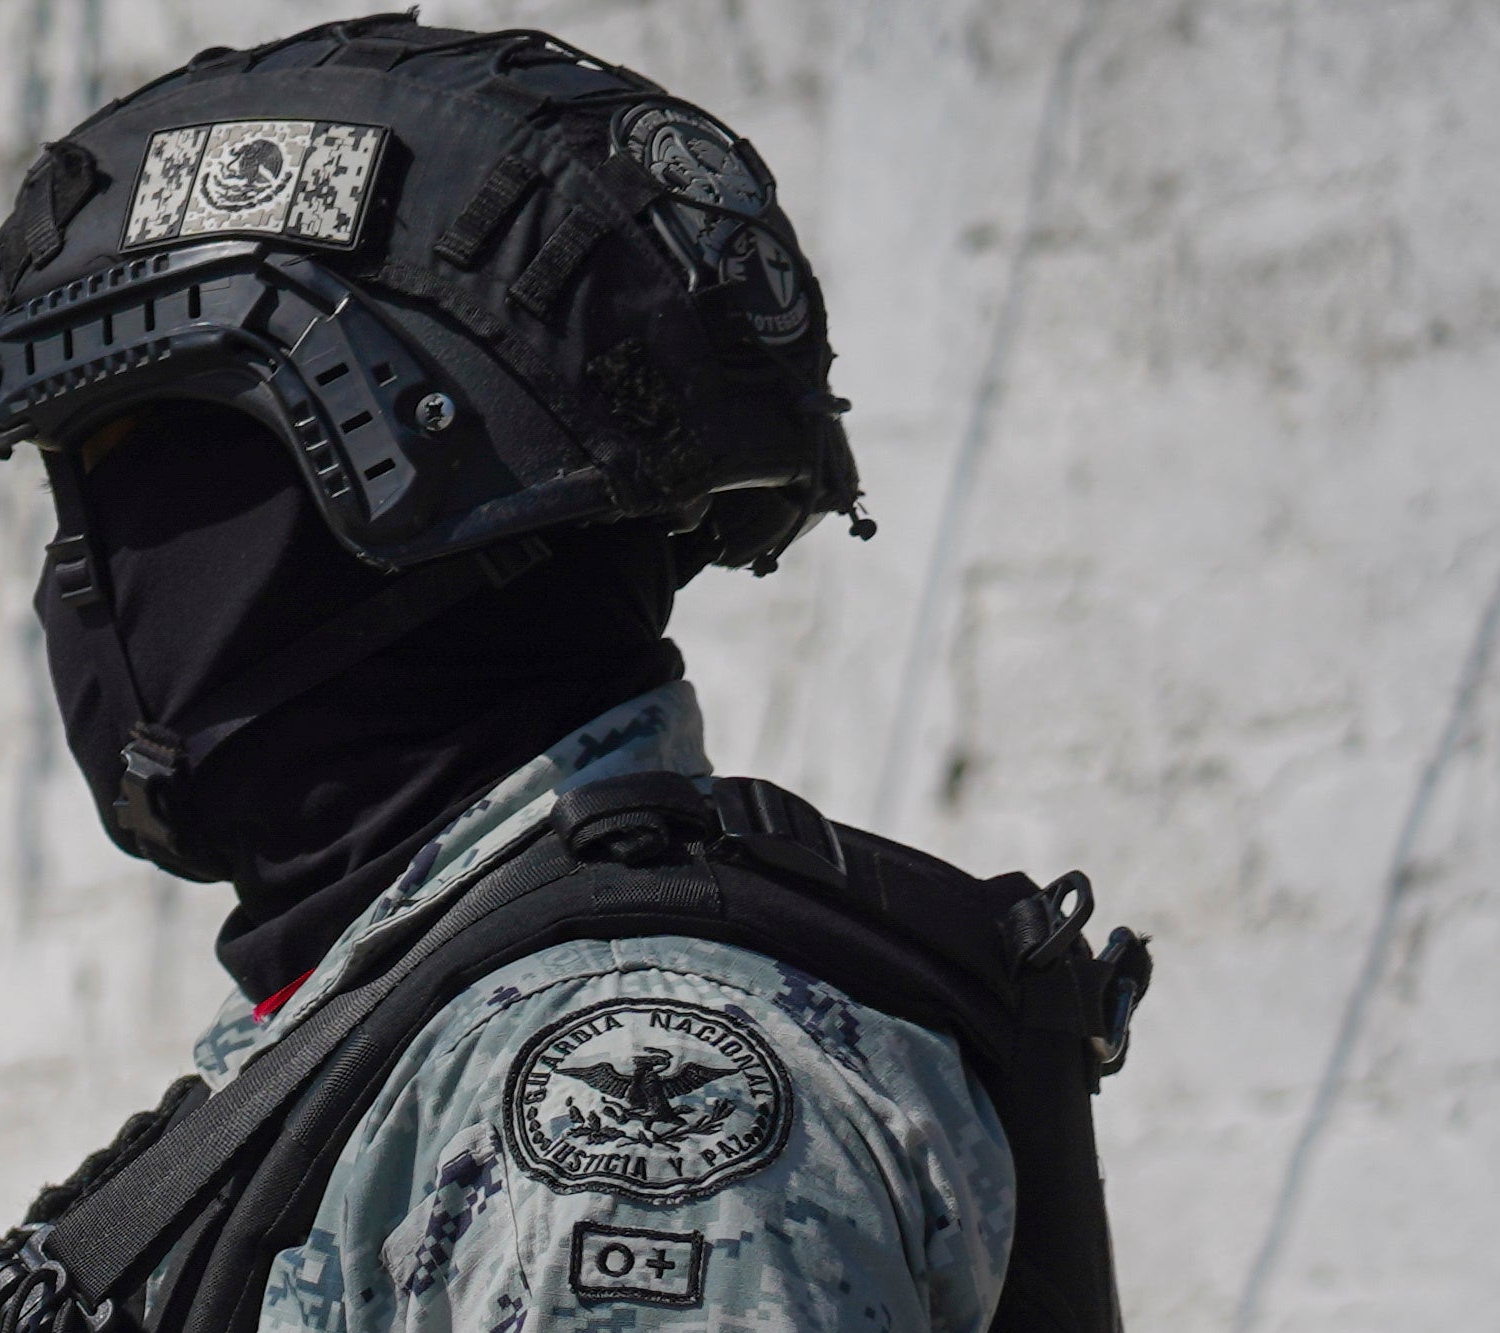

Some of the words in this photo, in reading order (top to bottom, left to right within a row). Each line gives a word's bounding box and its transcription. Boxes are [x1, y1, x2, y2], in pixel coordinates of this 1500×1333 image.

[524, 1013, 625, 1107] GUARDIA
[650, 1011, 773, 1099] NACIONAL
[542, 1136, 647, 1181] JUSTICIA
[666, 1158, 684, 1178] Y
[701, 1133, 750, 1168] PAZ
